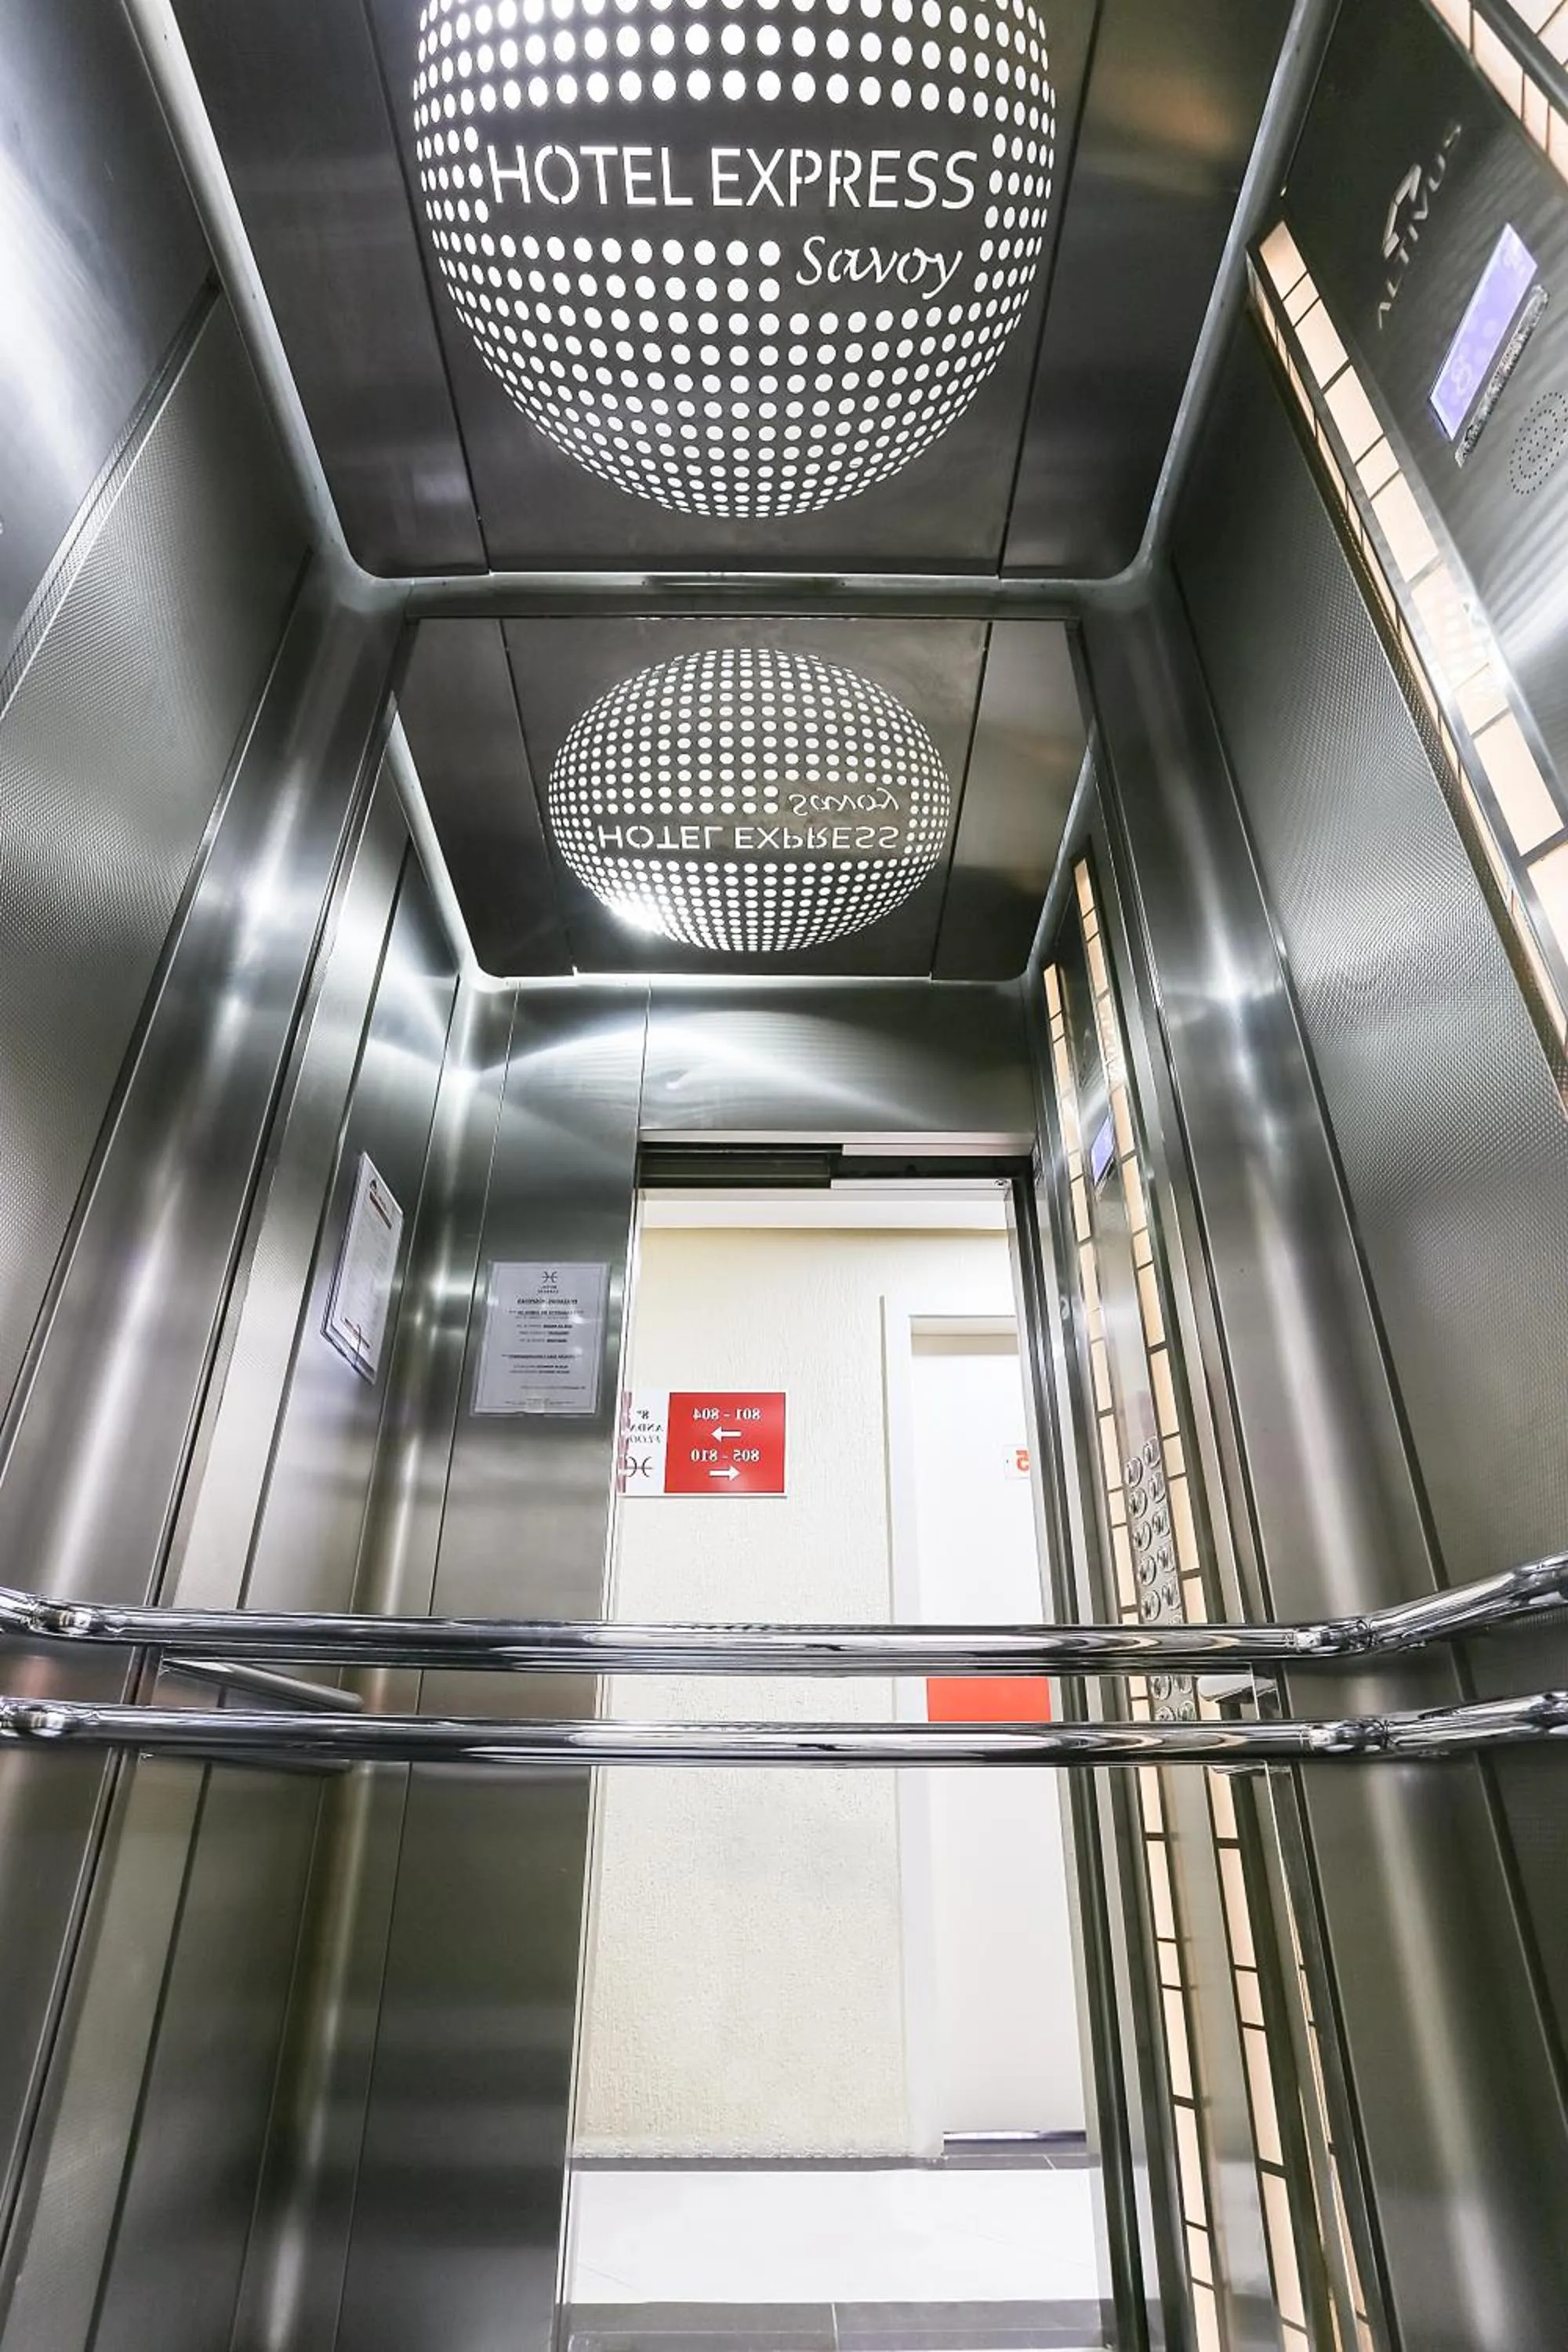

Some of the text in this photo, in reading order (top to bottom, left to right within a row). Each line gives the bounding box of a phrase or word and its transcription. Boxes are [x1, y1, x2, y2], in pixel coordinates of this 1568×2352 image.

[486, 144, 978, 209] HOTEL EXPRESS
[795, 235, 964, 300] Savoy
